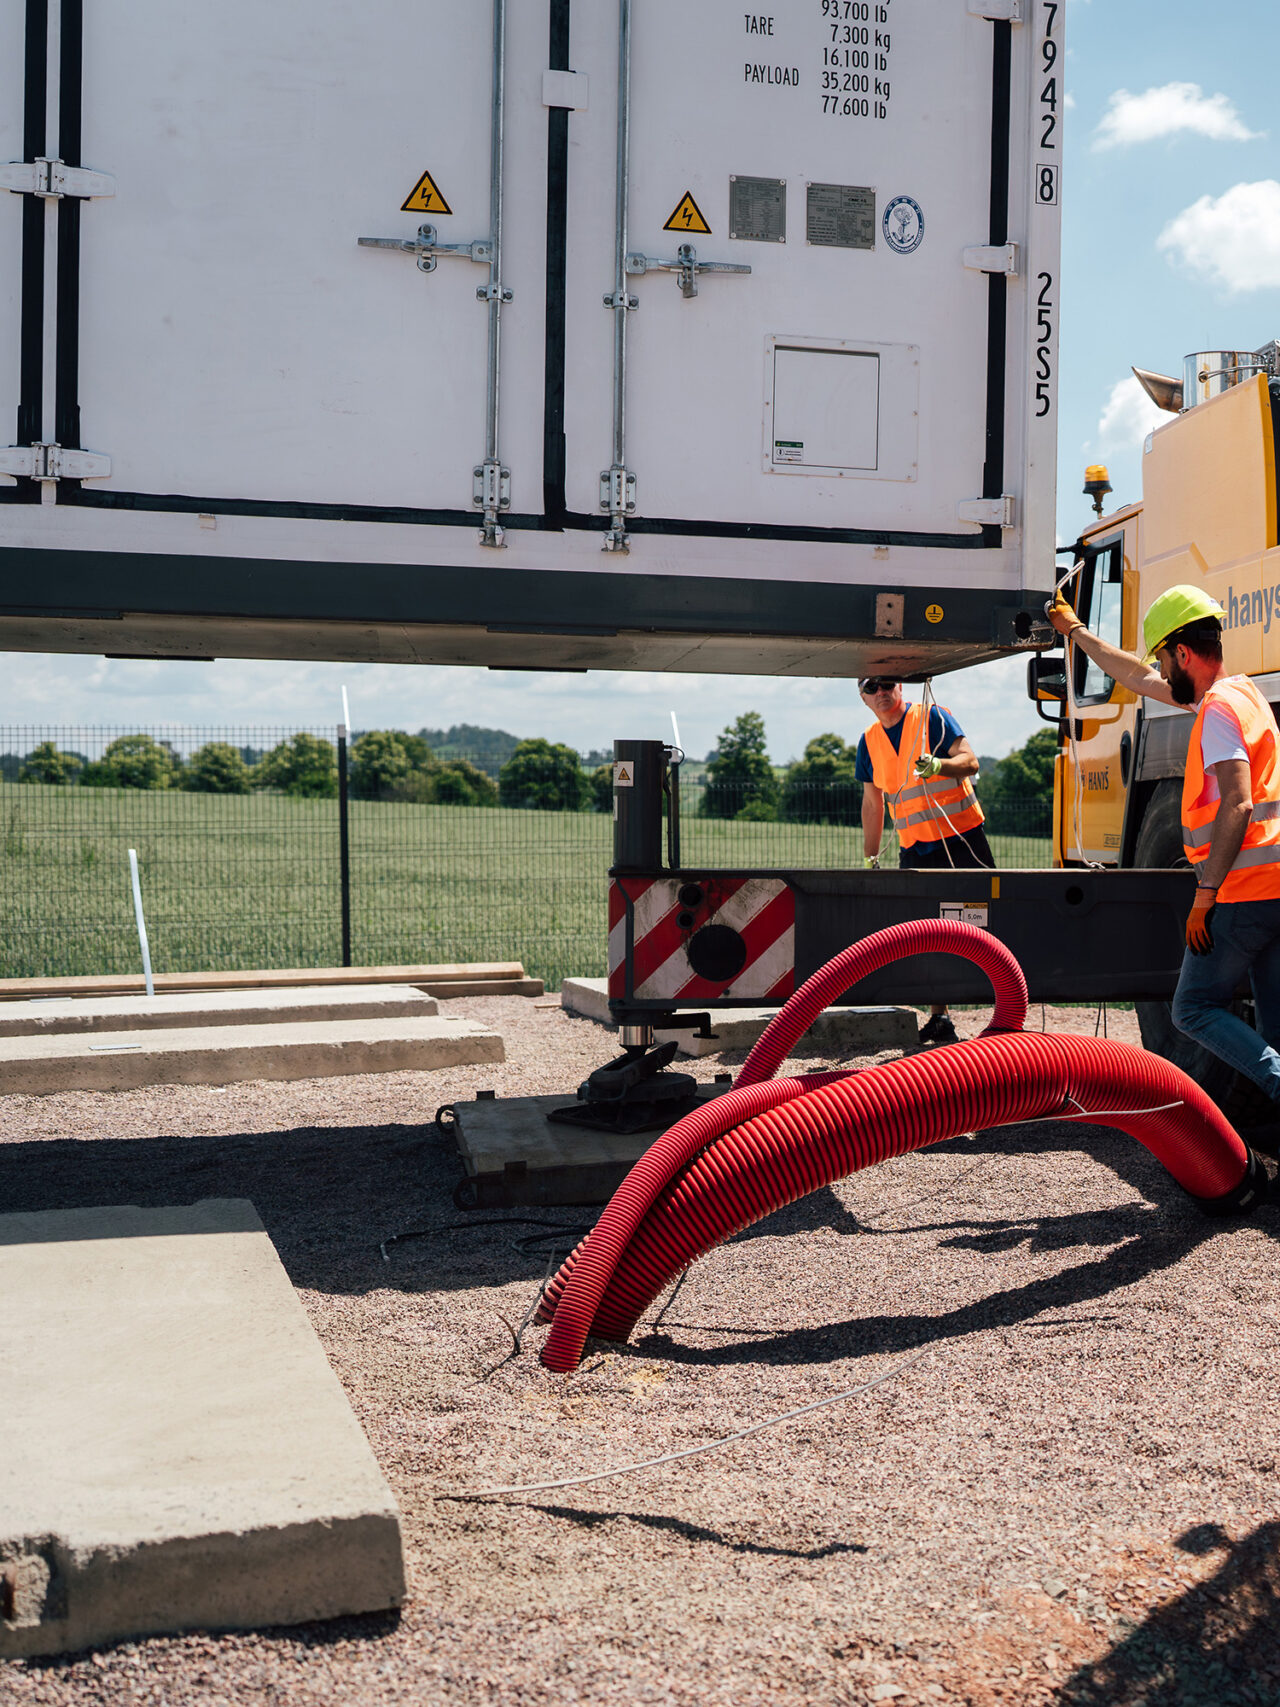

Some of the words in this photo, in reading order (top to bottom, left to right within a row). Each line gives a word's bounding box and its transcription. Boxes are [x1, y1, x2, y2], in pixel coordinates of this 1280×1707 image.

[821, 0, 869, 21] 93.700
[874, 5, 888, 23] lb
[744, 15, 775, 35] TARE
[830, 24, 869, 45] 7.300
[874, 29, 891, 53] kg
[823, 48, 869, 68] 16.100
[874, 53, 888, 71] lb
[1040, 2, 1058, 149] 7942
[744, 64, 800, 86] PAYLOAD
[821, 71, 869, 93] 35.200
[874, 77, 891, 101] kg
[821, 95, 869, 117] 77.600
[874, 101, 888, 119] lb
[1039, 168, 1054, 202] 8
